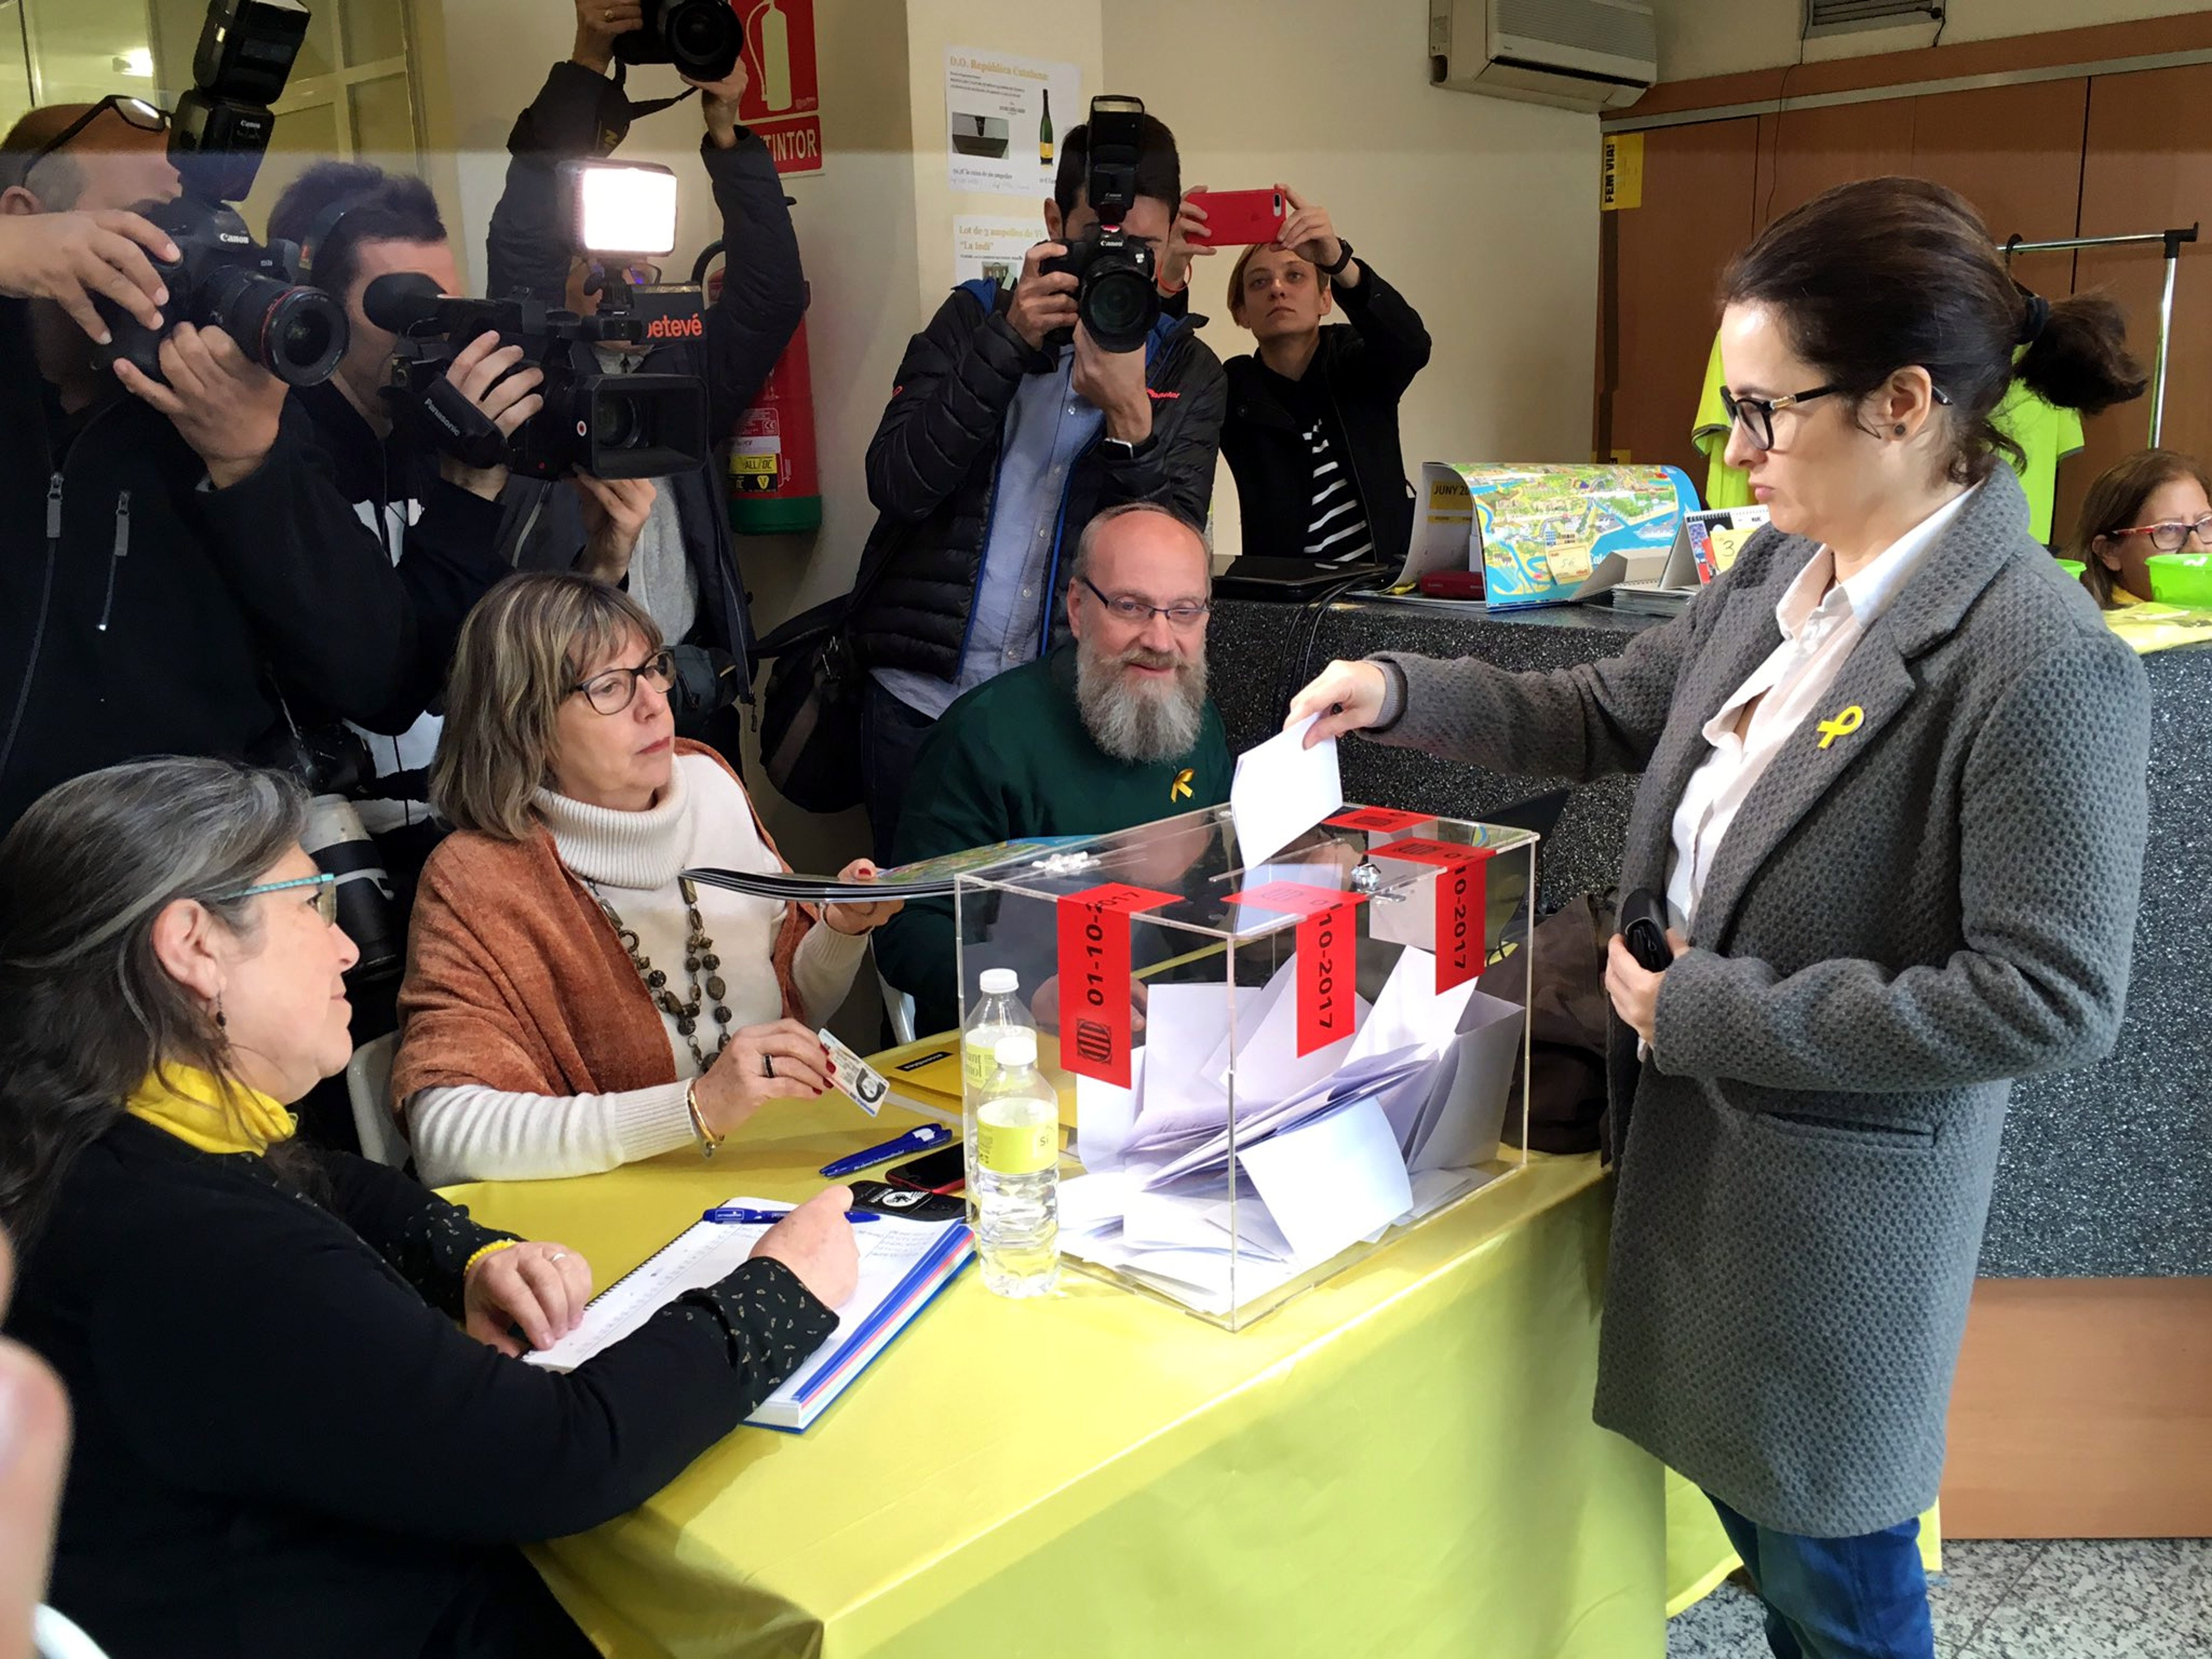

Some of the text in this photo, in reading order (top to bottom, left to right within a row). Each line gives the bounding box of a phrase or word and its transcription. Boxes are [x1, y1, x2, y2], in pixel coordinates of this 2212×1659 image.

[761, 129, 817, 162] TINTOR
[1605, 174, 1614, 202] FEM
[220, 233, 249, 243] Canon
[424, 398, 460, 436] Panasonic
[1434, 485, 1458, 495] JUNY
[1722, 540, 1735, 557] 3
